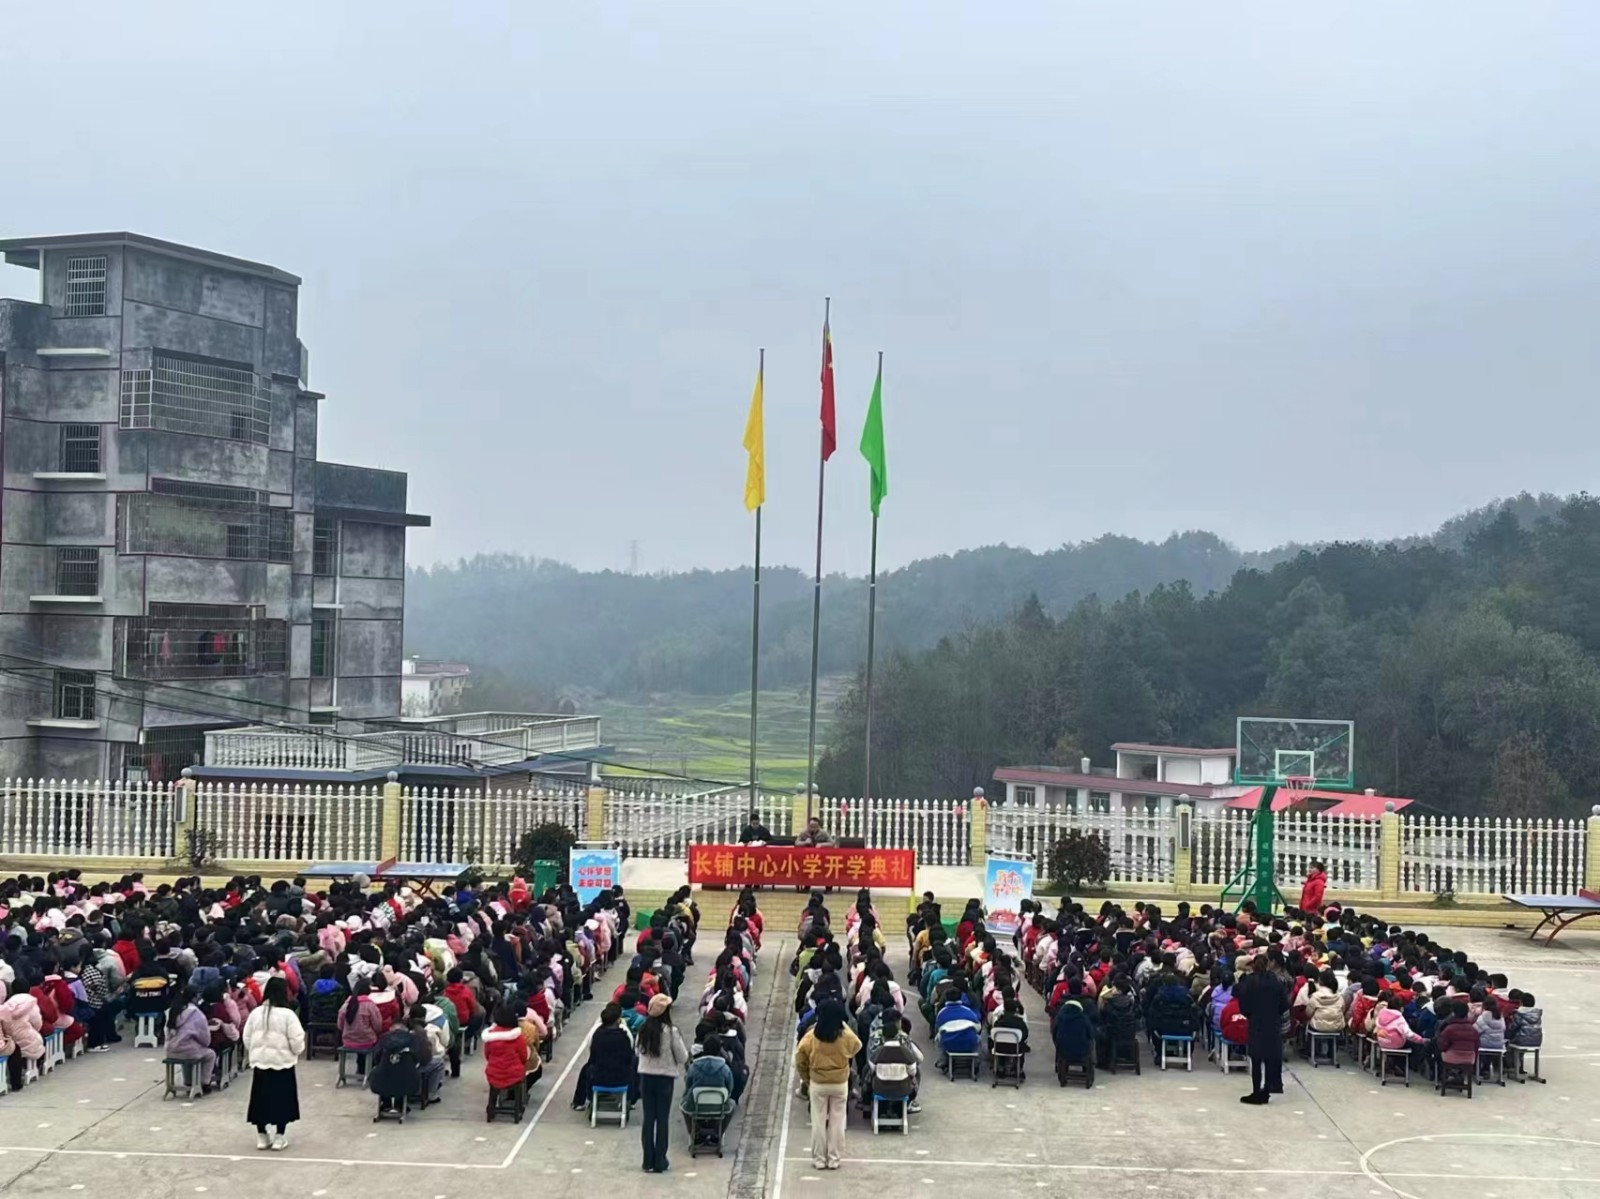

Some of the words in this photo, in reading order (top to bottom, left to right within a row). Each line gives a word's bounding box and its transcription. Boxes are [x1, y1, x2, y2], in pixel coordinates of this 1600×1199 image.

[692, 851, 909, 881] 长铺中心小学开学典礼
